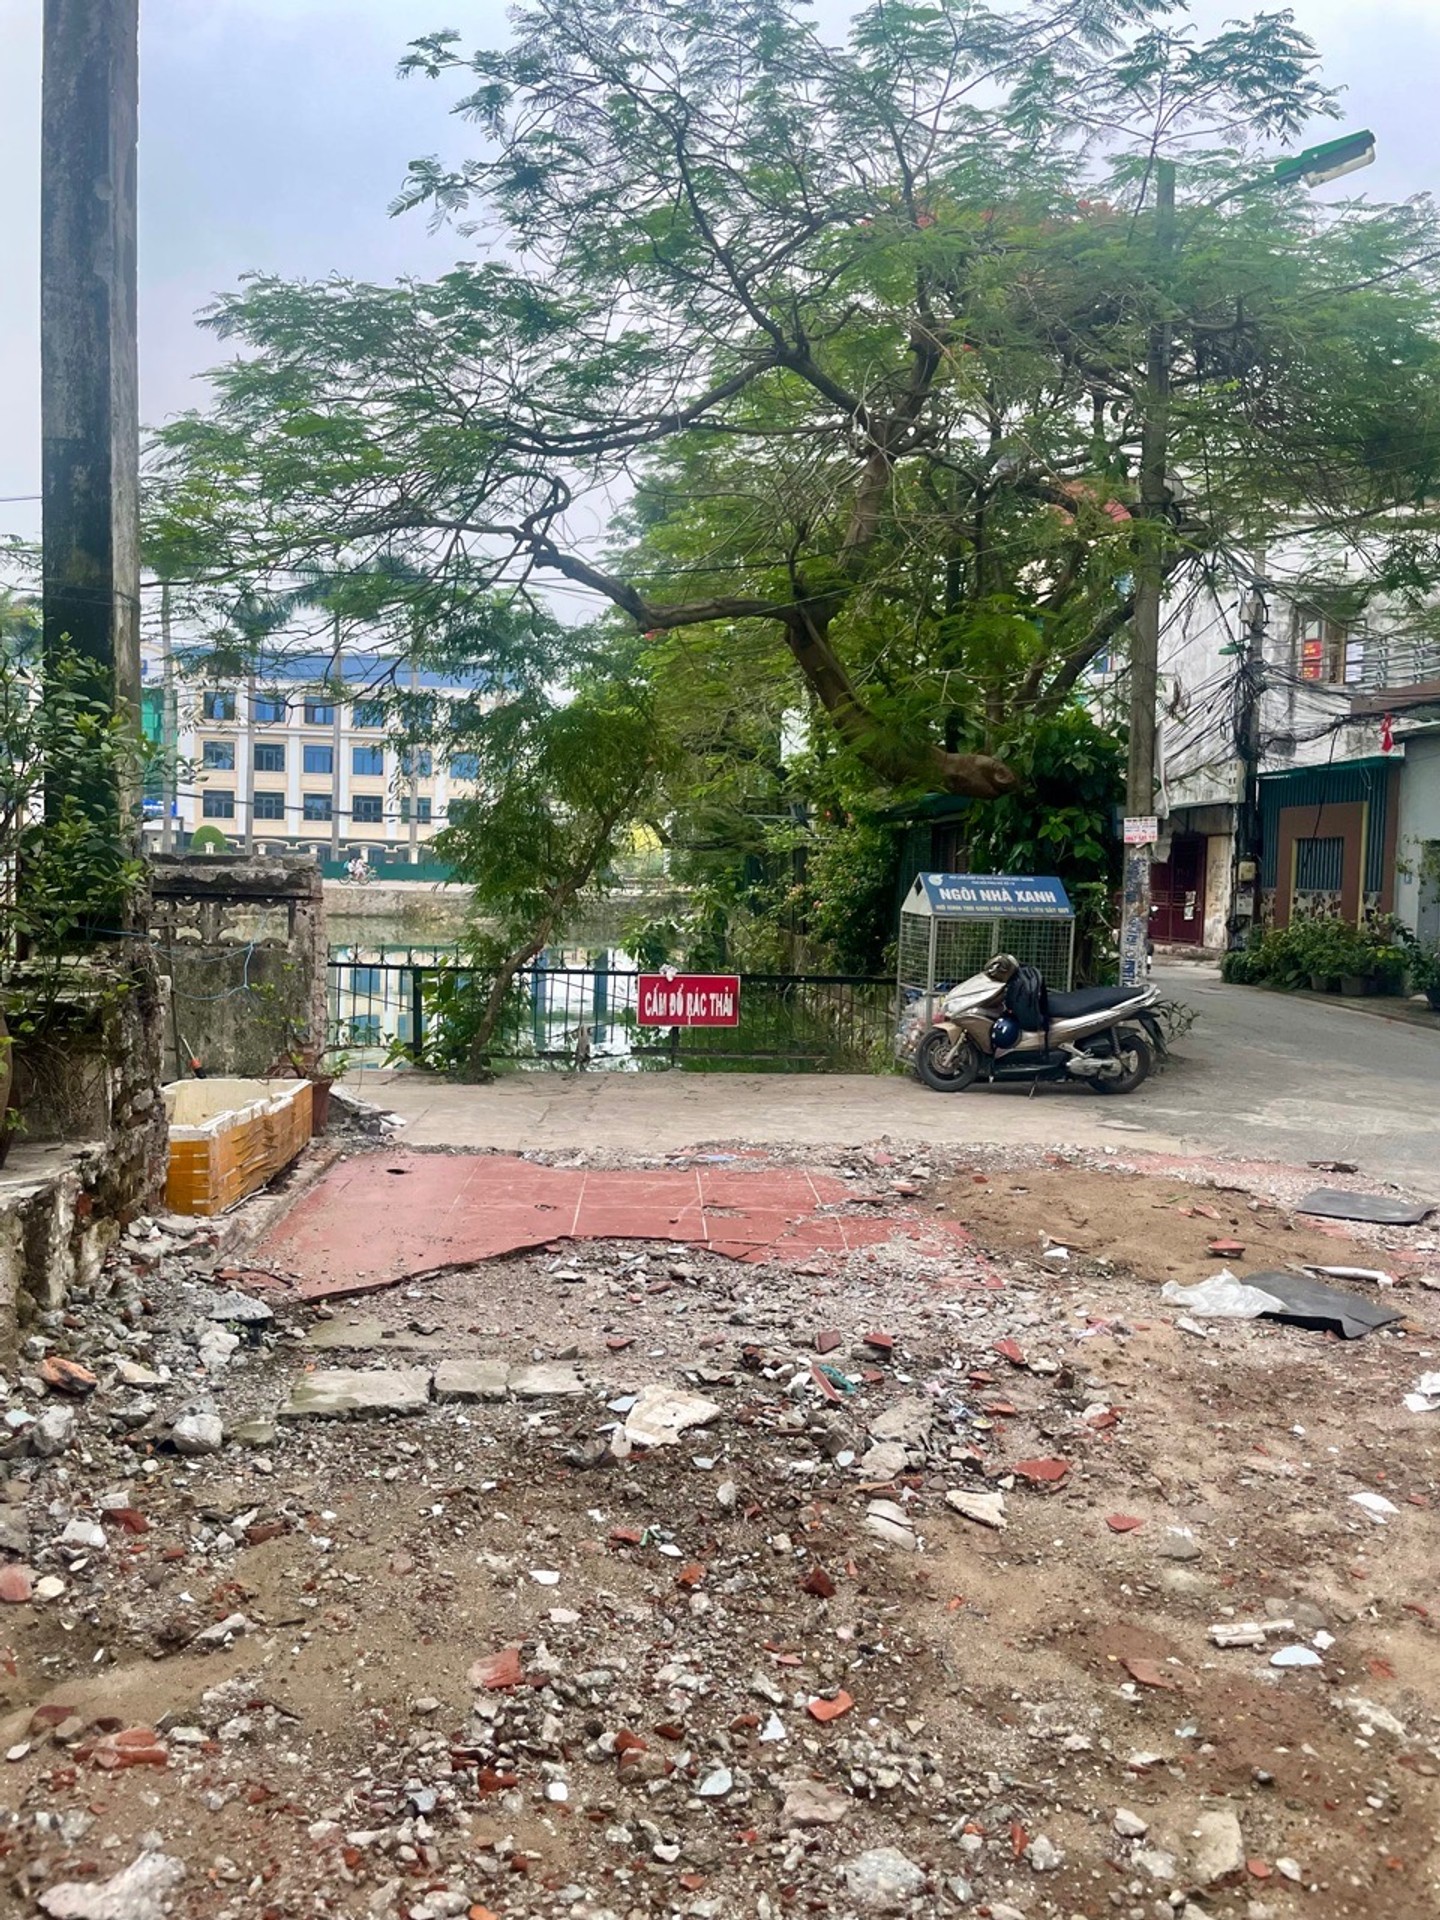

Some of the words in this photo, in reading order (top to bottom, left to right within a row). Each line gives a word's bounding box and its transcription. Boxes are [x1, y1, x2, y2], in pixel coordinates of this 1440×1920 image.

[939, 886, 977, 902] NGÔI
[979, 887, 1013, 903] NHÀ
[1014, 890, 1057, 903] XANH
[644, 982, 667, 1017] CẤM
[669, 982, 684, 1017] ĐỔ
[686, 986, 707, 1017] RÁC
[709, 986, 734, 1017] THẢI
